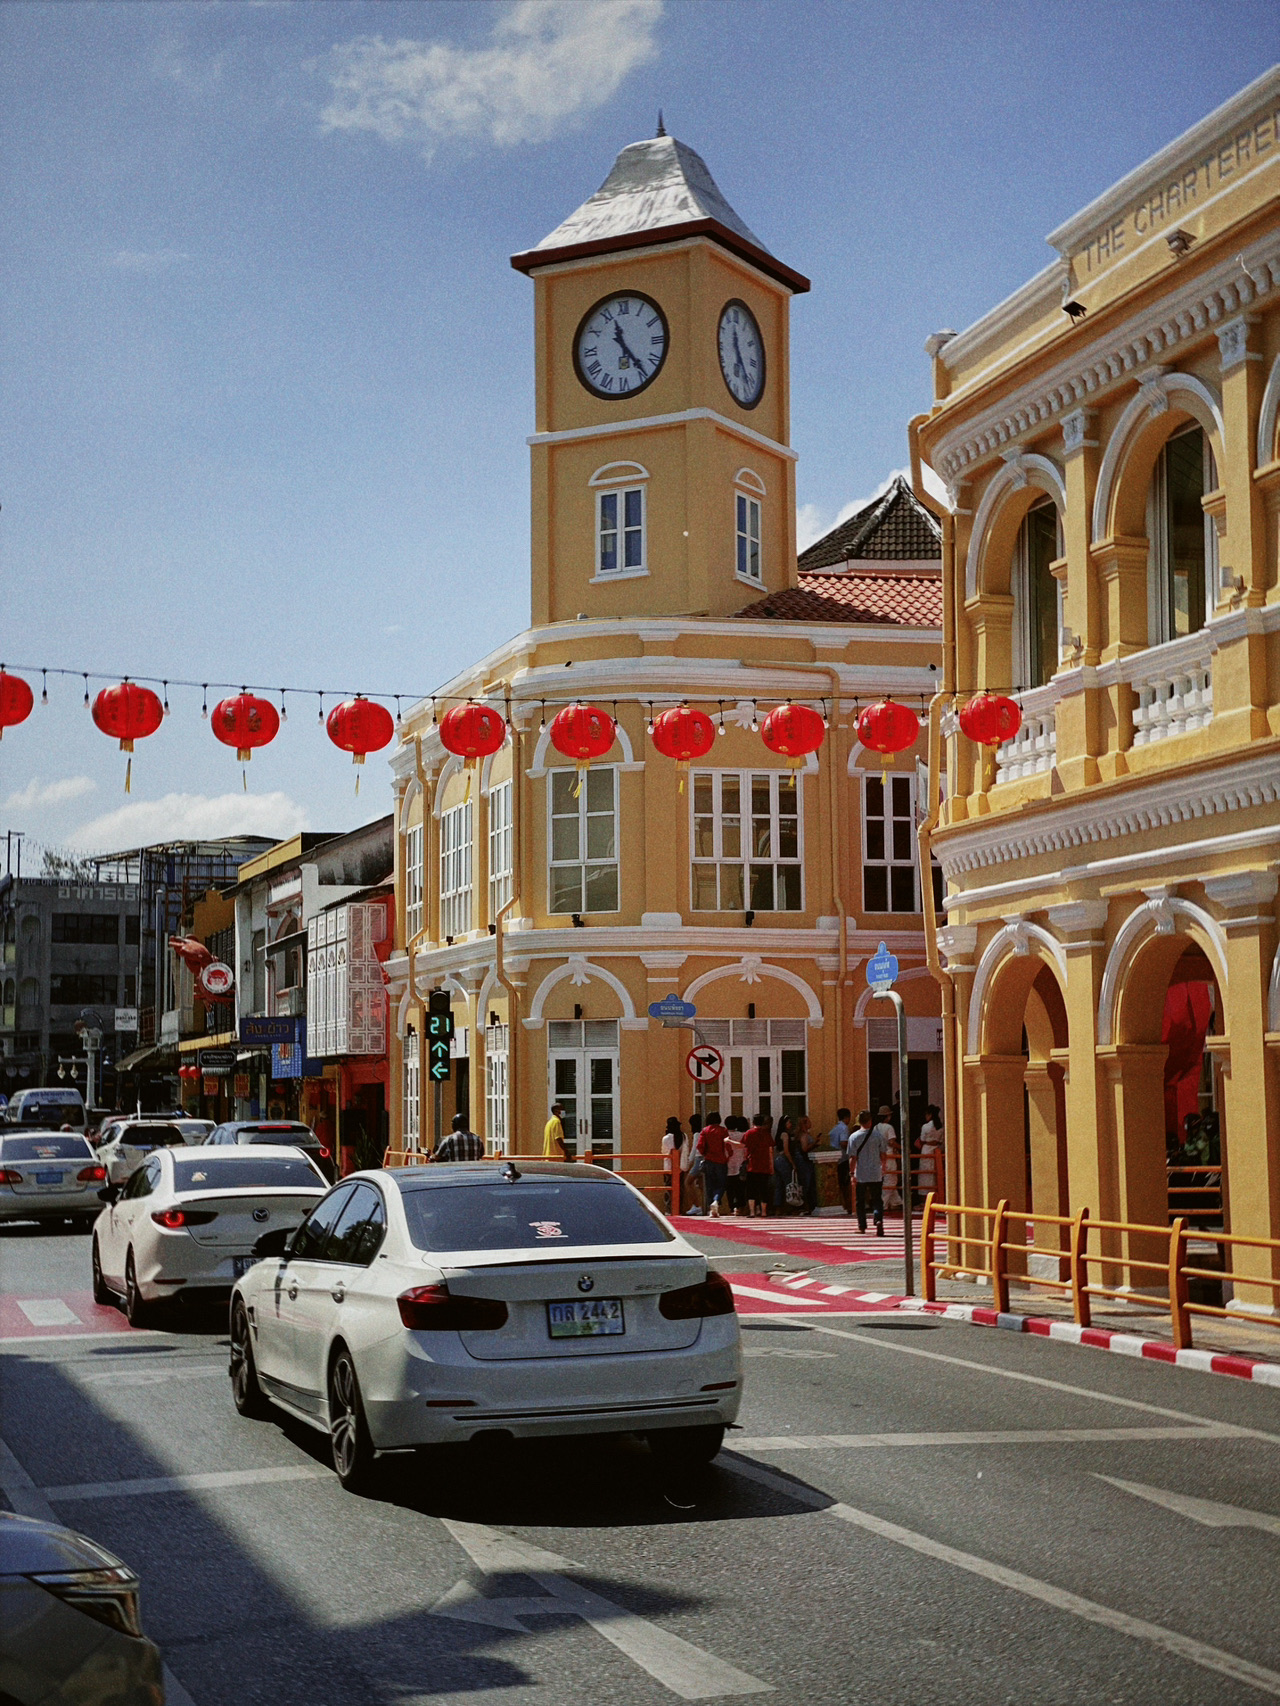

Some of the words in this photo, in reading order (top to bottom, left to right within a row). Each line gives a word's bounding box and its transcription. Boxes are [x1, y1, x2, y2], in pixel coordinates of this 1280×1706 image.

[1082, 219, 1125, 272] THE
[617, 300, 630, 315] XII
[600, 307, 615, 324] XI
[646, 315, 660, 328] II
[588, 326, 602, 338] X
[651, 335, 664, 345] III
[584, 346, 598, 357] IX
[648, 352, 660, 367] IV
[586, 359, 603, 380] VIII
[600, 372, 614, 391] VII
[619, 376, 631, 391] VI
[430, 1017, 450, 1034] 21
[580, 1302, 619, 1320] 2442
